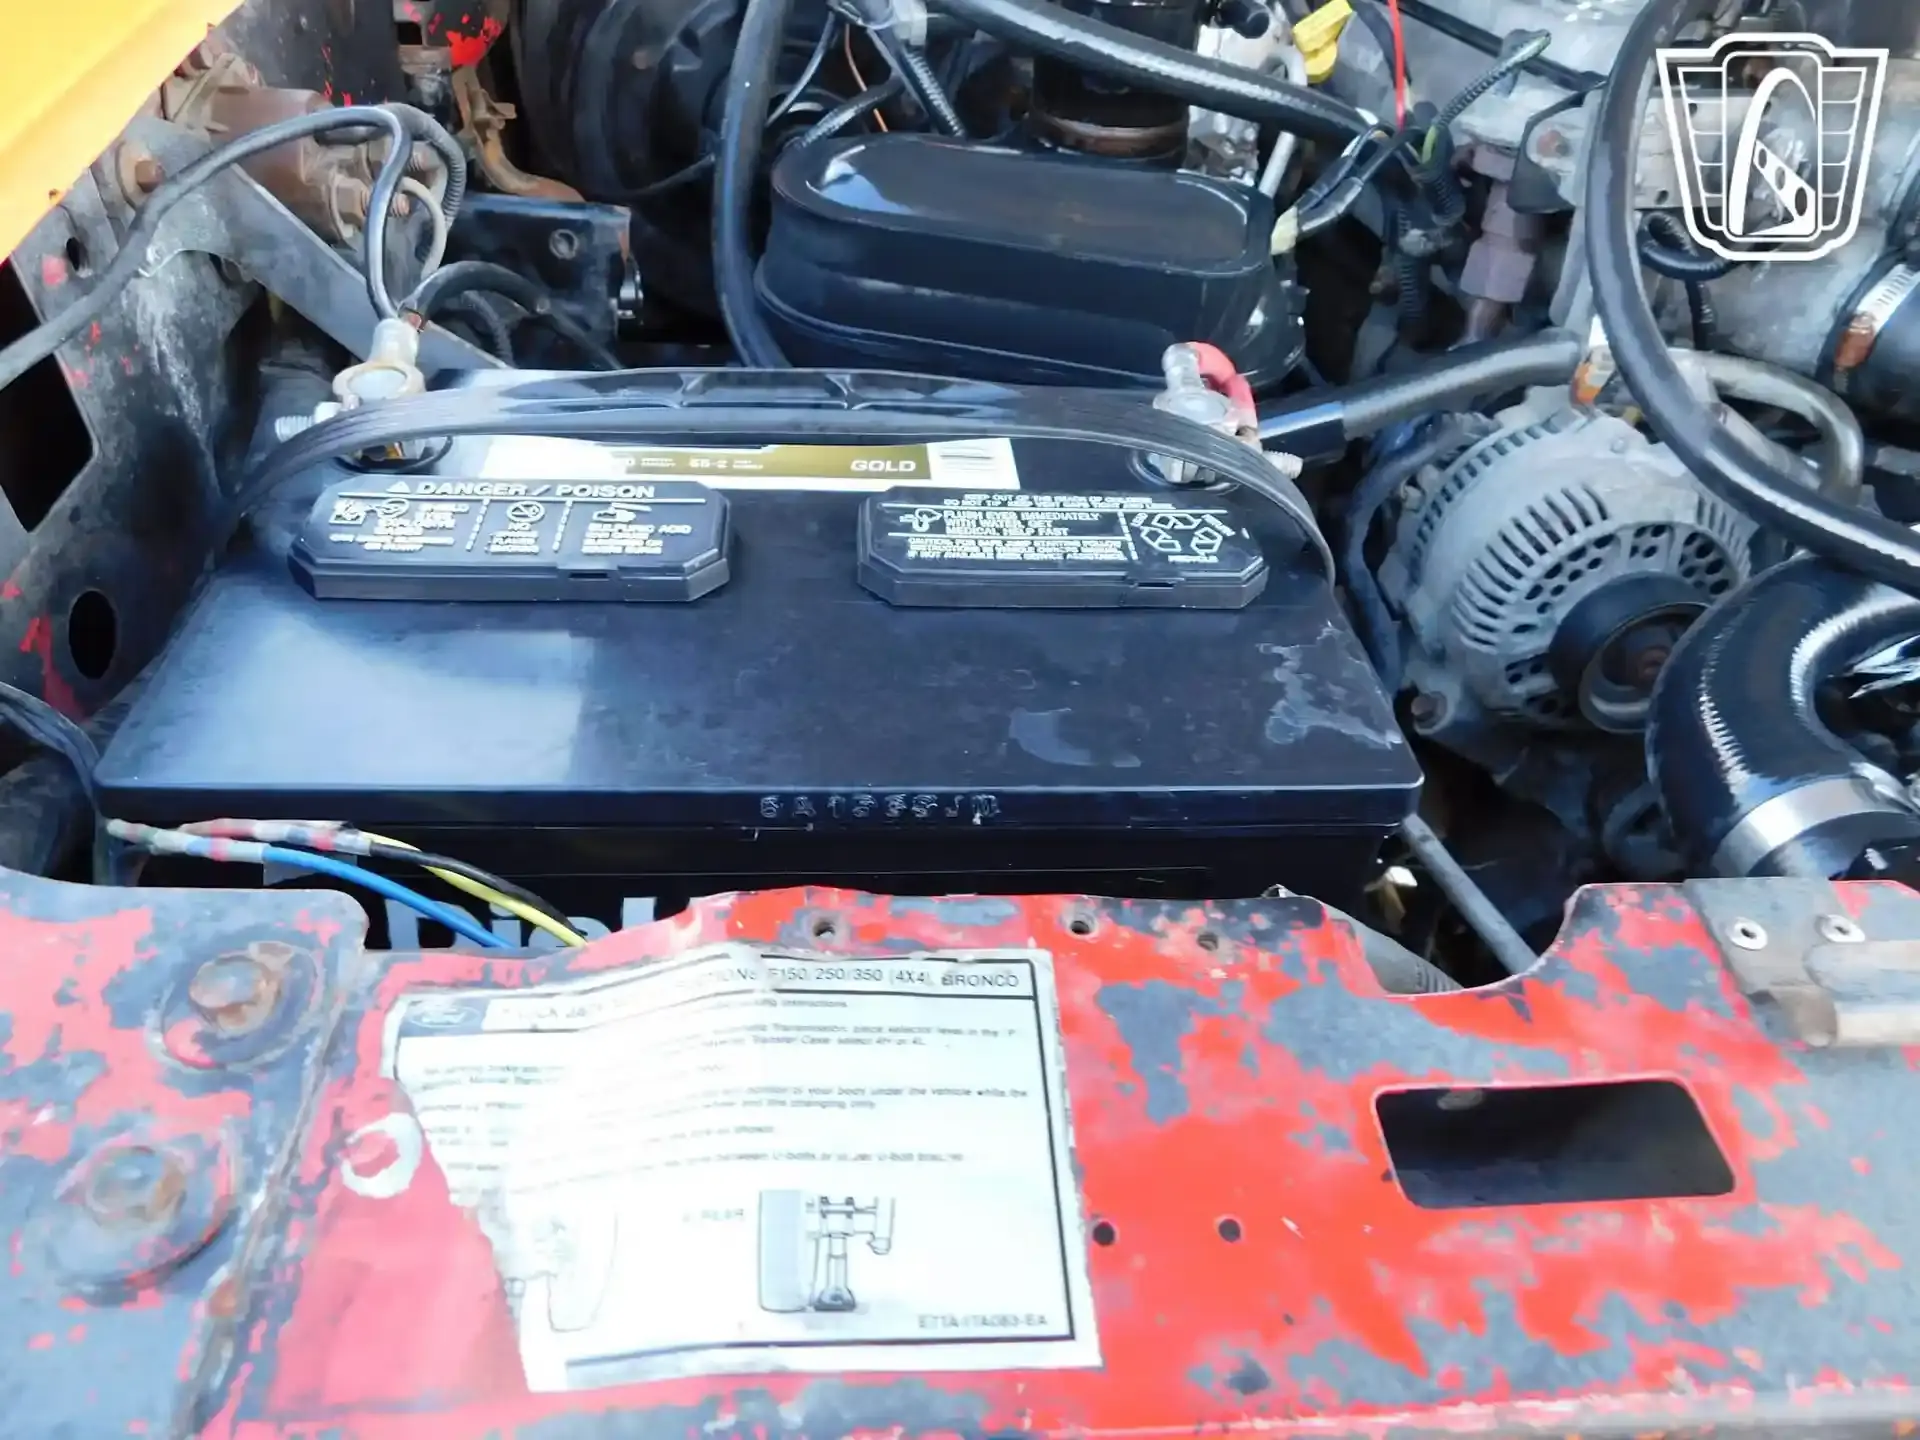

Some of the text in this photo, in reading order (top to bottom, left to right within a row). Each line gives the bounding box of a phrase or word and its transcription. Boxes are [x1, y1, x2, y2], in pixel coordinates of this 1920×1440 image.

[850, 458, 917, 473] GOLD
[417, 481, 531, 497] DANGER
[559, 485, 656, 498] POISON
[943, 510, 1101, 522] FLUSH EYES IMMEDIATELY
[945, 519, 977, 528] WITH
[1027, 520, 1053, 529] GET
[946, 526, 1070, 537] MEDICAL HELP FAST
[941, 973, 1020, 987] BRONCO
